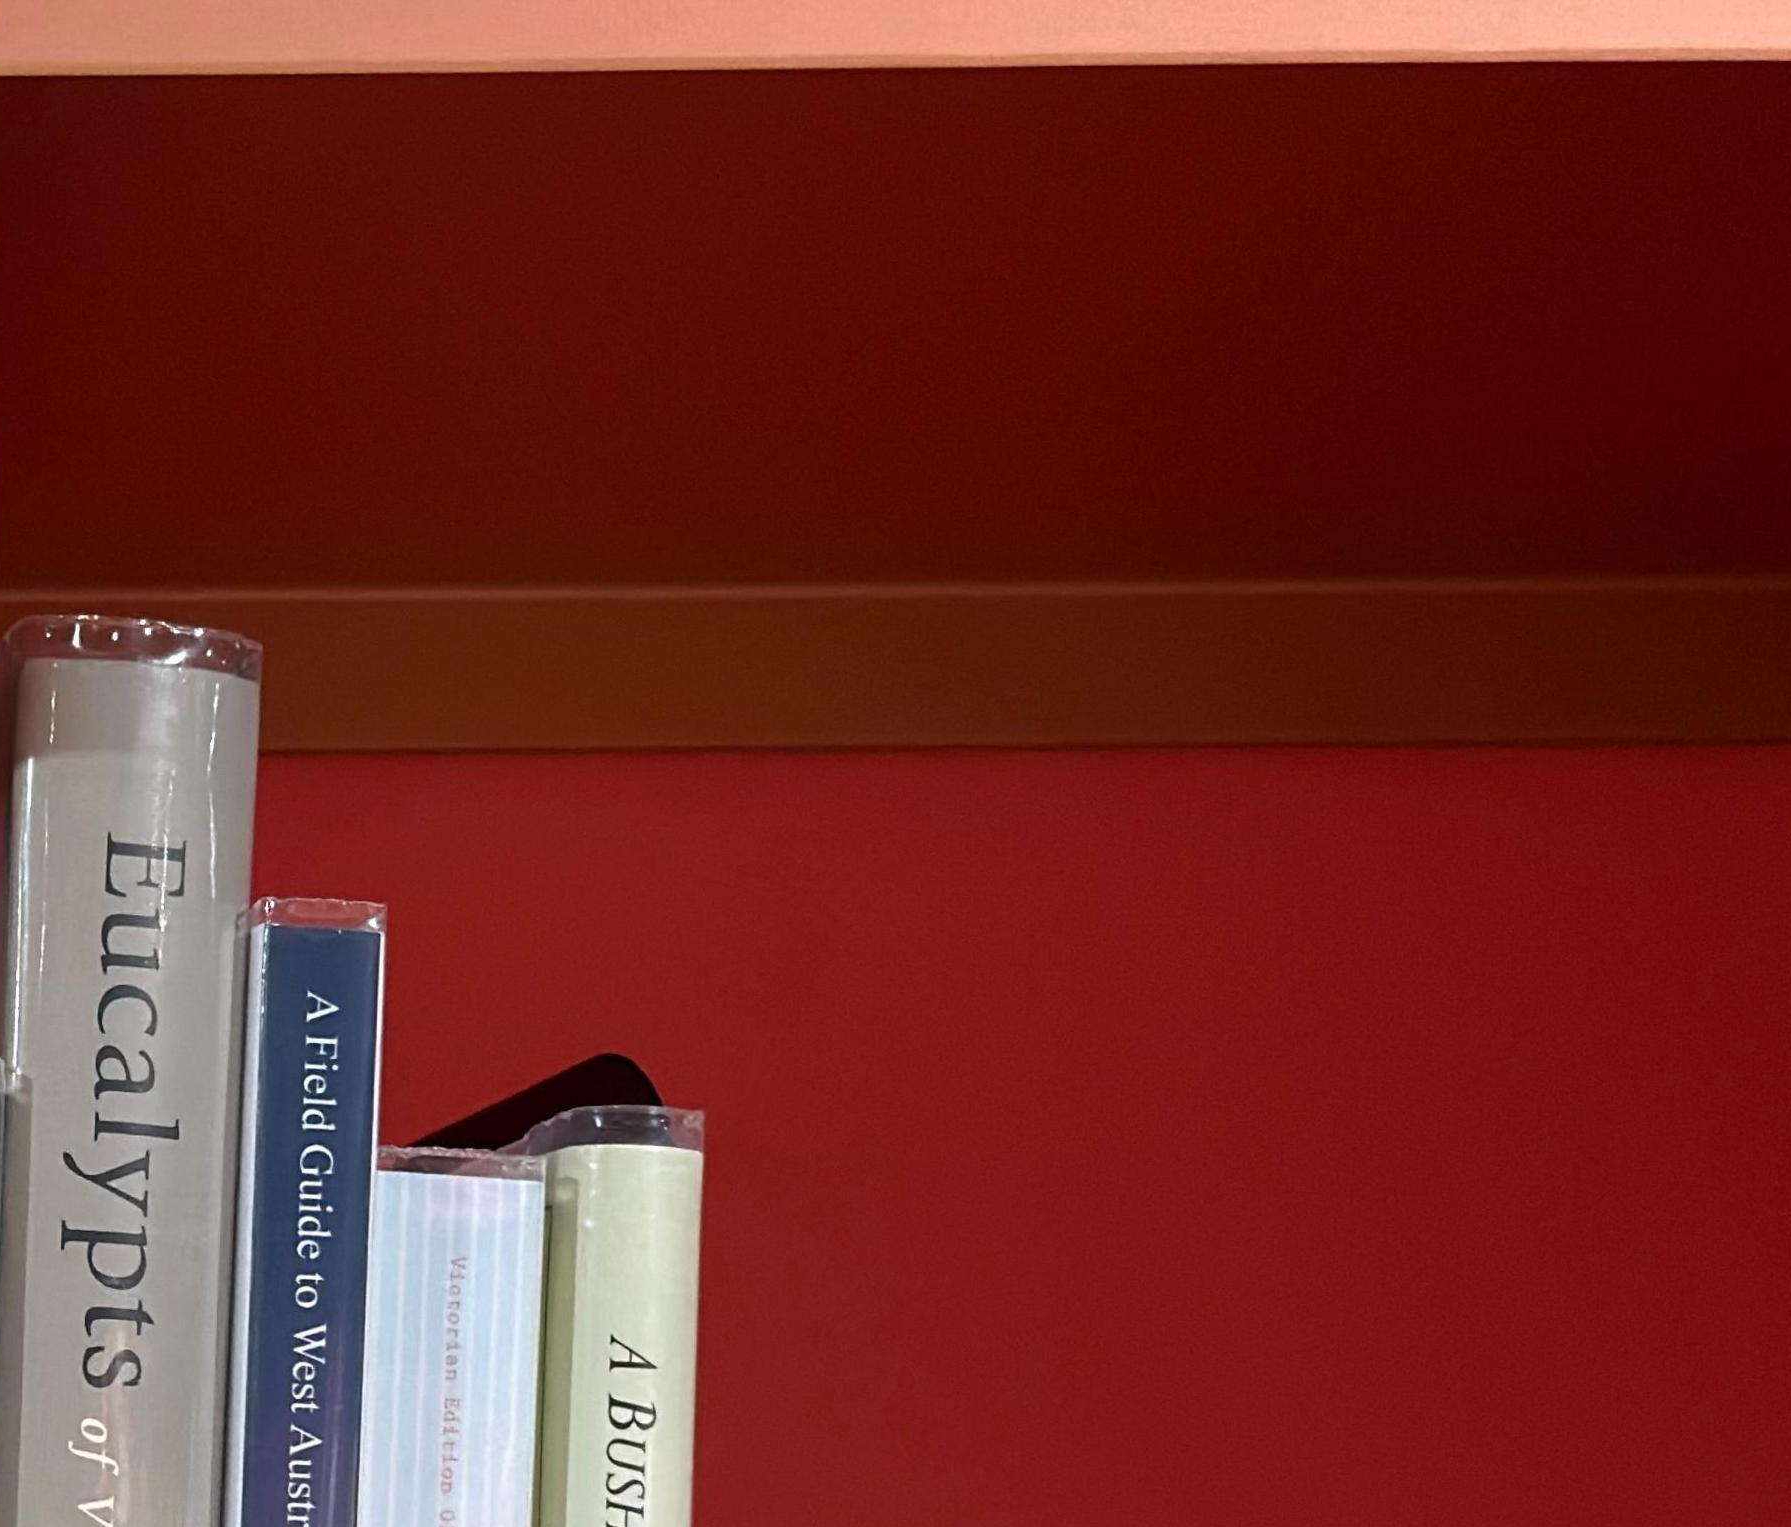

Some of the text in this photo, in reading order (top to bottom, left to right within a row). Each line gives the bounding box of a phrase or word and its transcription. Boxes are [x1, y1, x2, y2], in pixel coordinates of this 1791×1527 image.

[306, 989, 340, 1023] A
[61, 831, 187, 1389] Eucalypts
[302, 1035, 338, 1136] Field
[297, 1144, 334, 1261] Guide
[295, 1273, 325, 1309] to
[445, 1256, 467, 1382] Victorian
[291, 1322, 328, 1414] West
[608, 1333, 658, 1371] A
[68, 1417, 119, 1477] of
[440, 1397, 460, 1494] Edition
